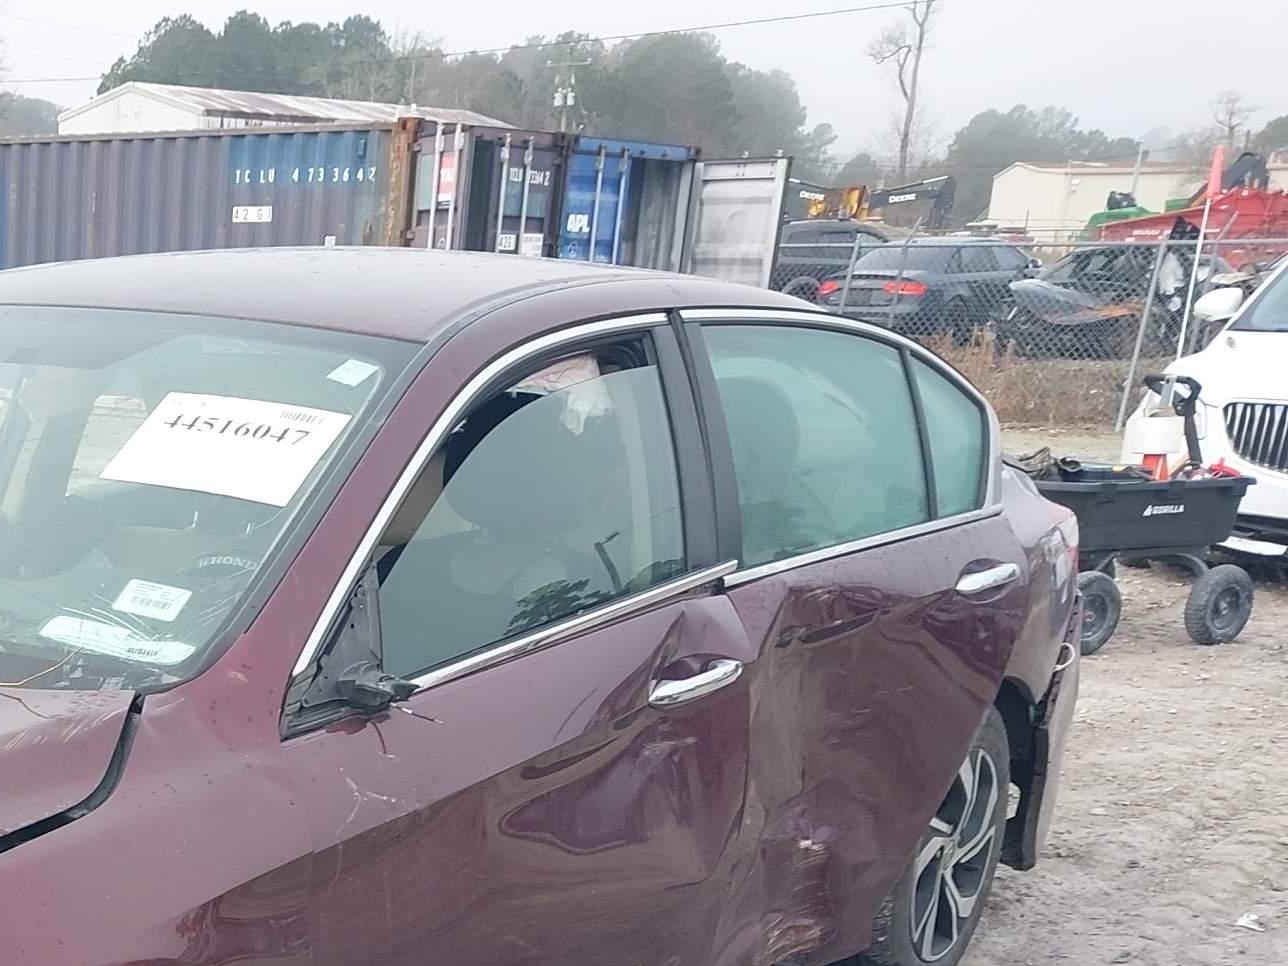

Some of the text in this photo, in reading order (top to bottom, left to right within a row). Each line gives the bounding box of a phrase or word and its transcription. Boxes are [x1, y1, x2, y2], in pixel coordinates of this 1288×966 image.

[888, 193, 917, 203] DEERE
[566, 213, 590, 233] APL
[163, 413, 312, 446] 44516047
[211, 556, 259, 570] HOND
